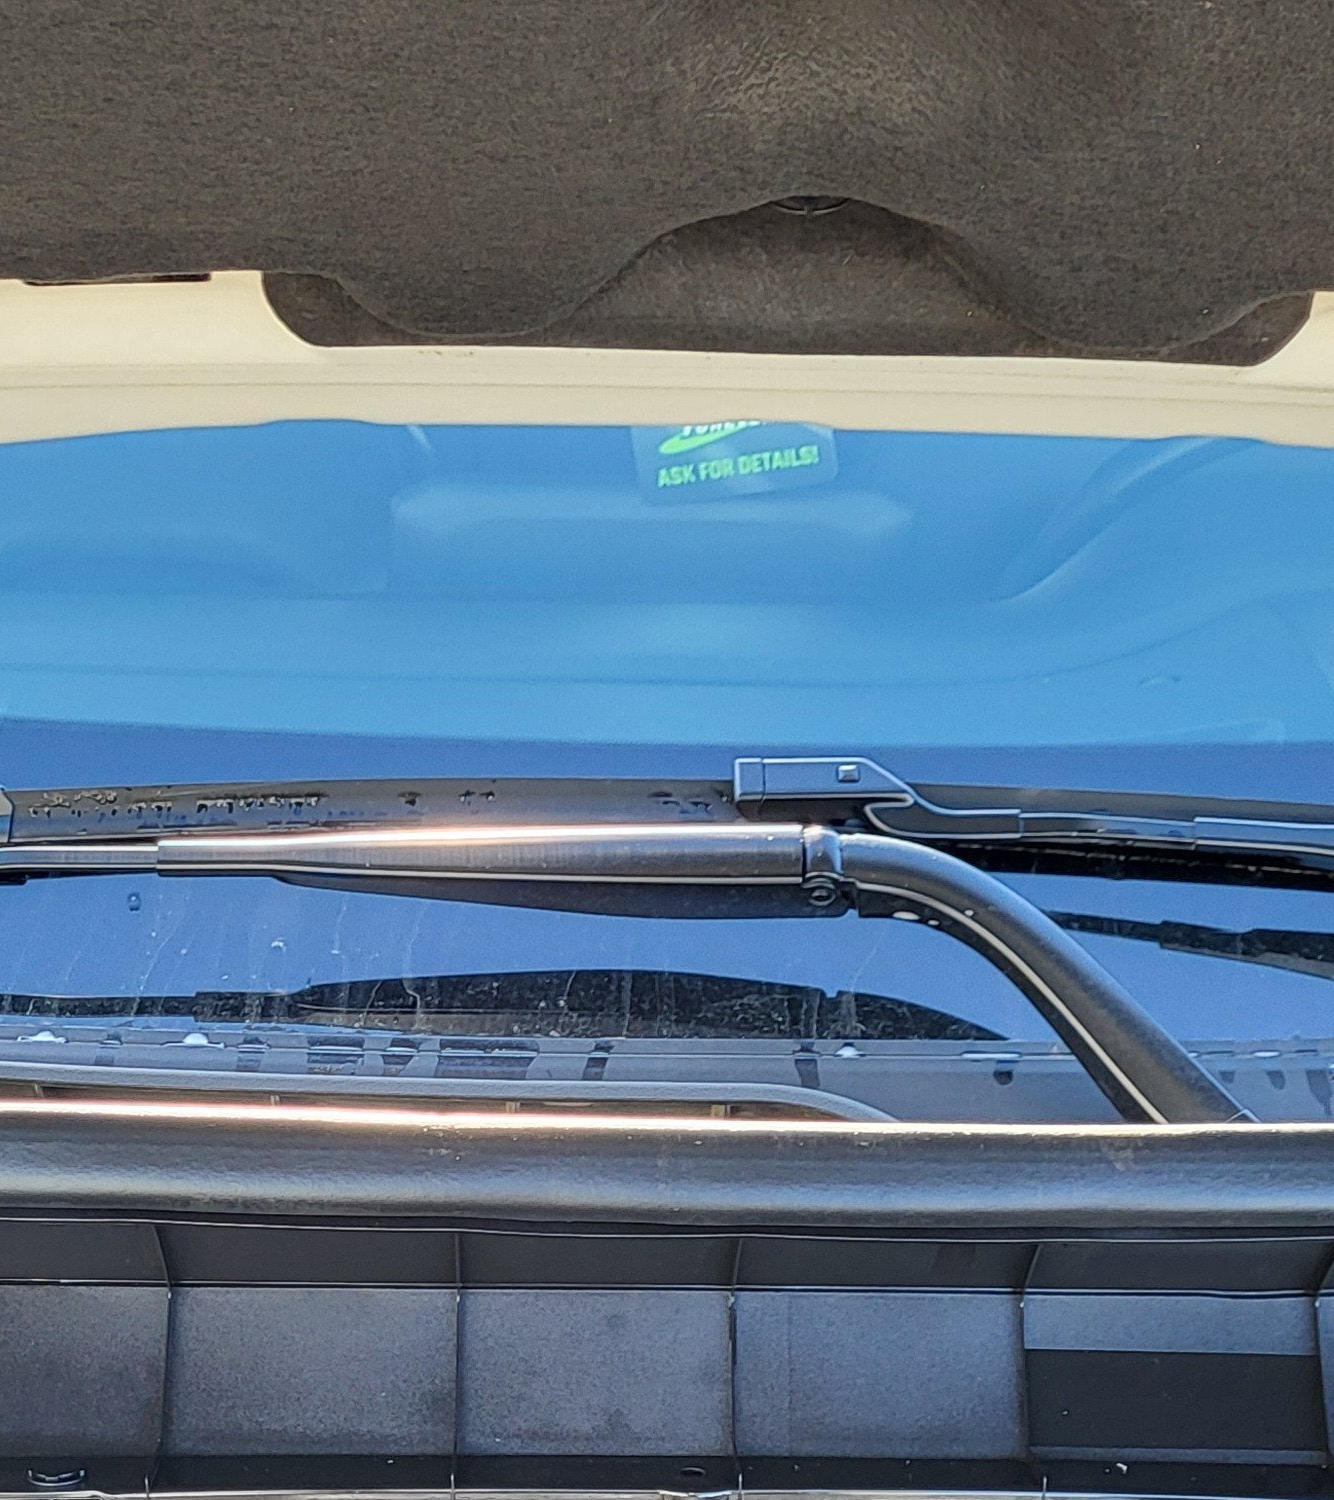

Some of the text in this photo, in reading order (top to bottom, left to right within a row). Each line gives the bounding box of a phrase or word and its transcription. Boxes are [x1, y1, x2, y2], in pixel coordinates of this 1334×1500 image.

[657, 445, 819, 488] ASK FOR DETAILS!
